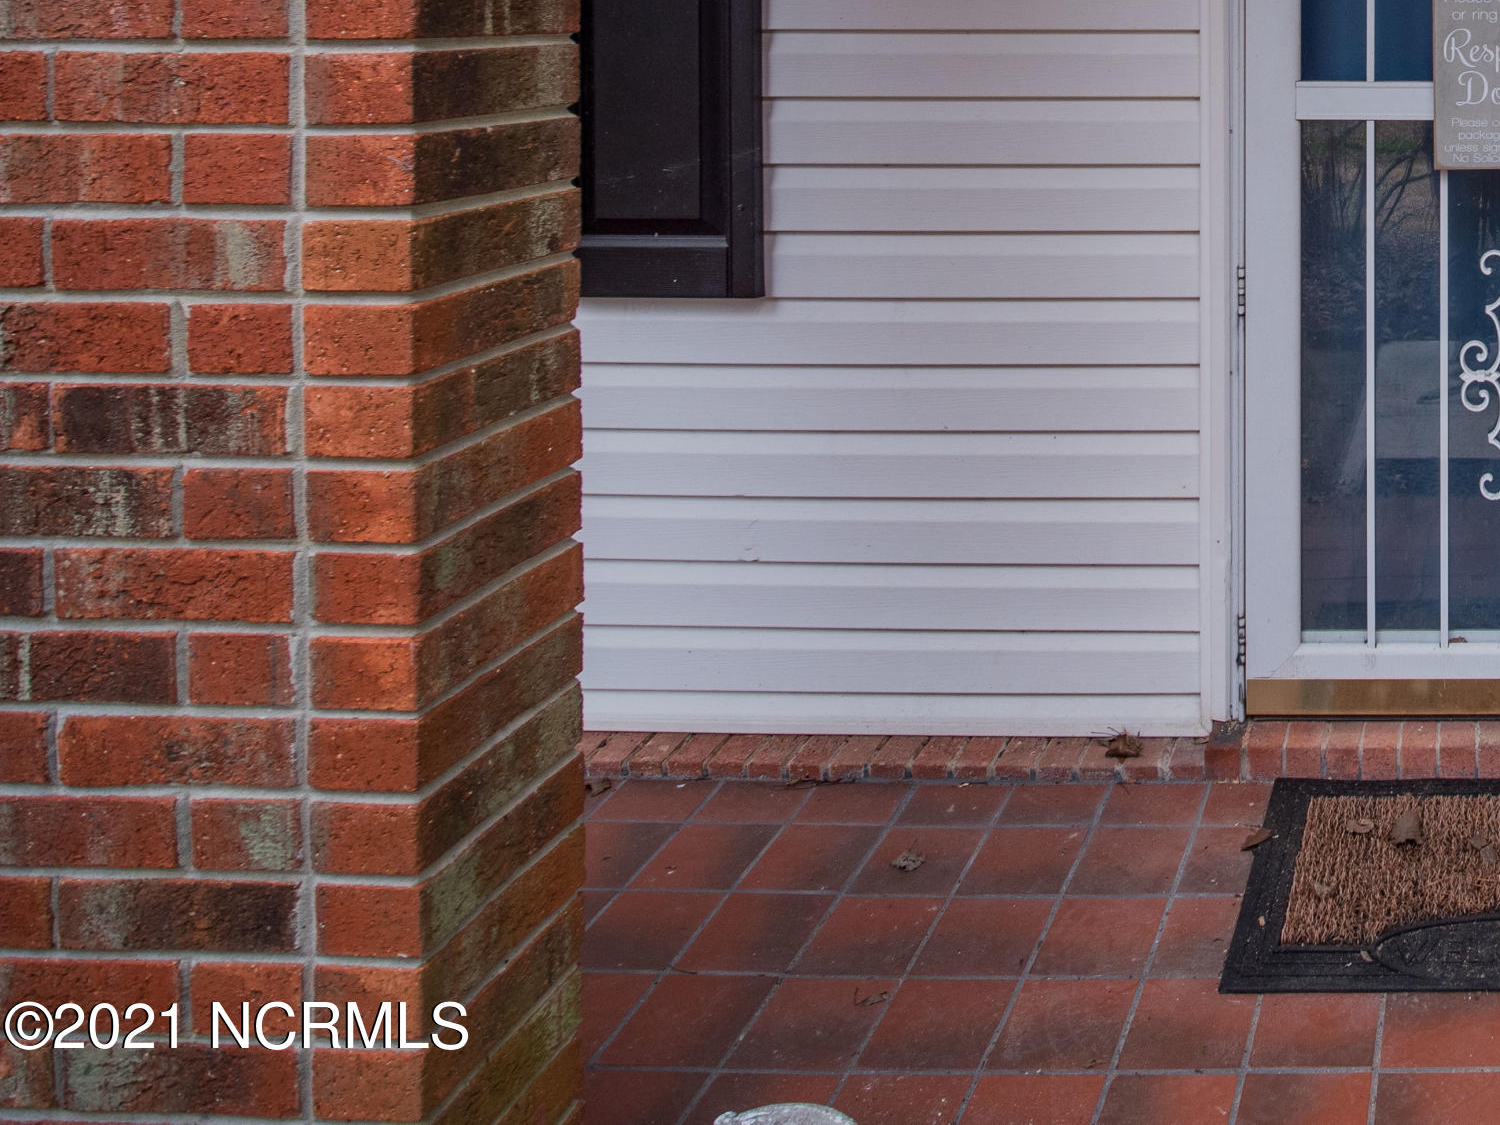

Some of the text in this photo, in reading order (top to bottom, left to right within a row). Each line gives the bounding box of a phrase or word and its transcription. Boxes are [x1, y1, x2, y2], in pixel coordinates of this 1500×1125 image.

[1452, 10, 1464, 21] or
[1473, 9, 1497, 22] ring
[1451, 117, 1488, 127] Please
[1445, 143, 1478, 152] unless
[1453, 154, 1469, 162] No
